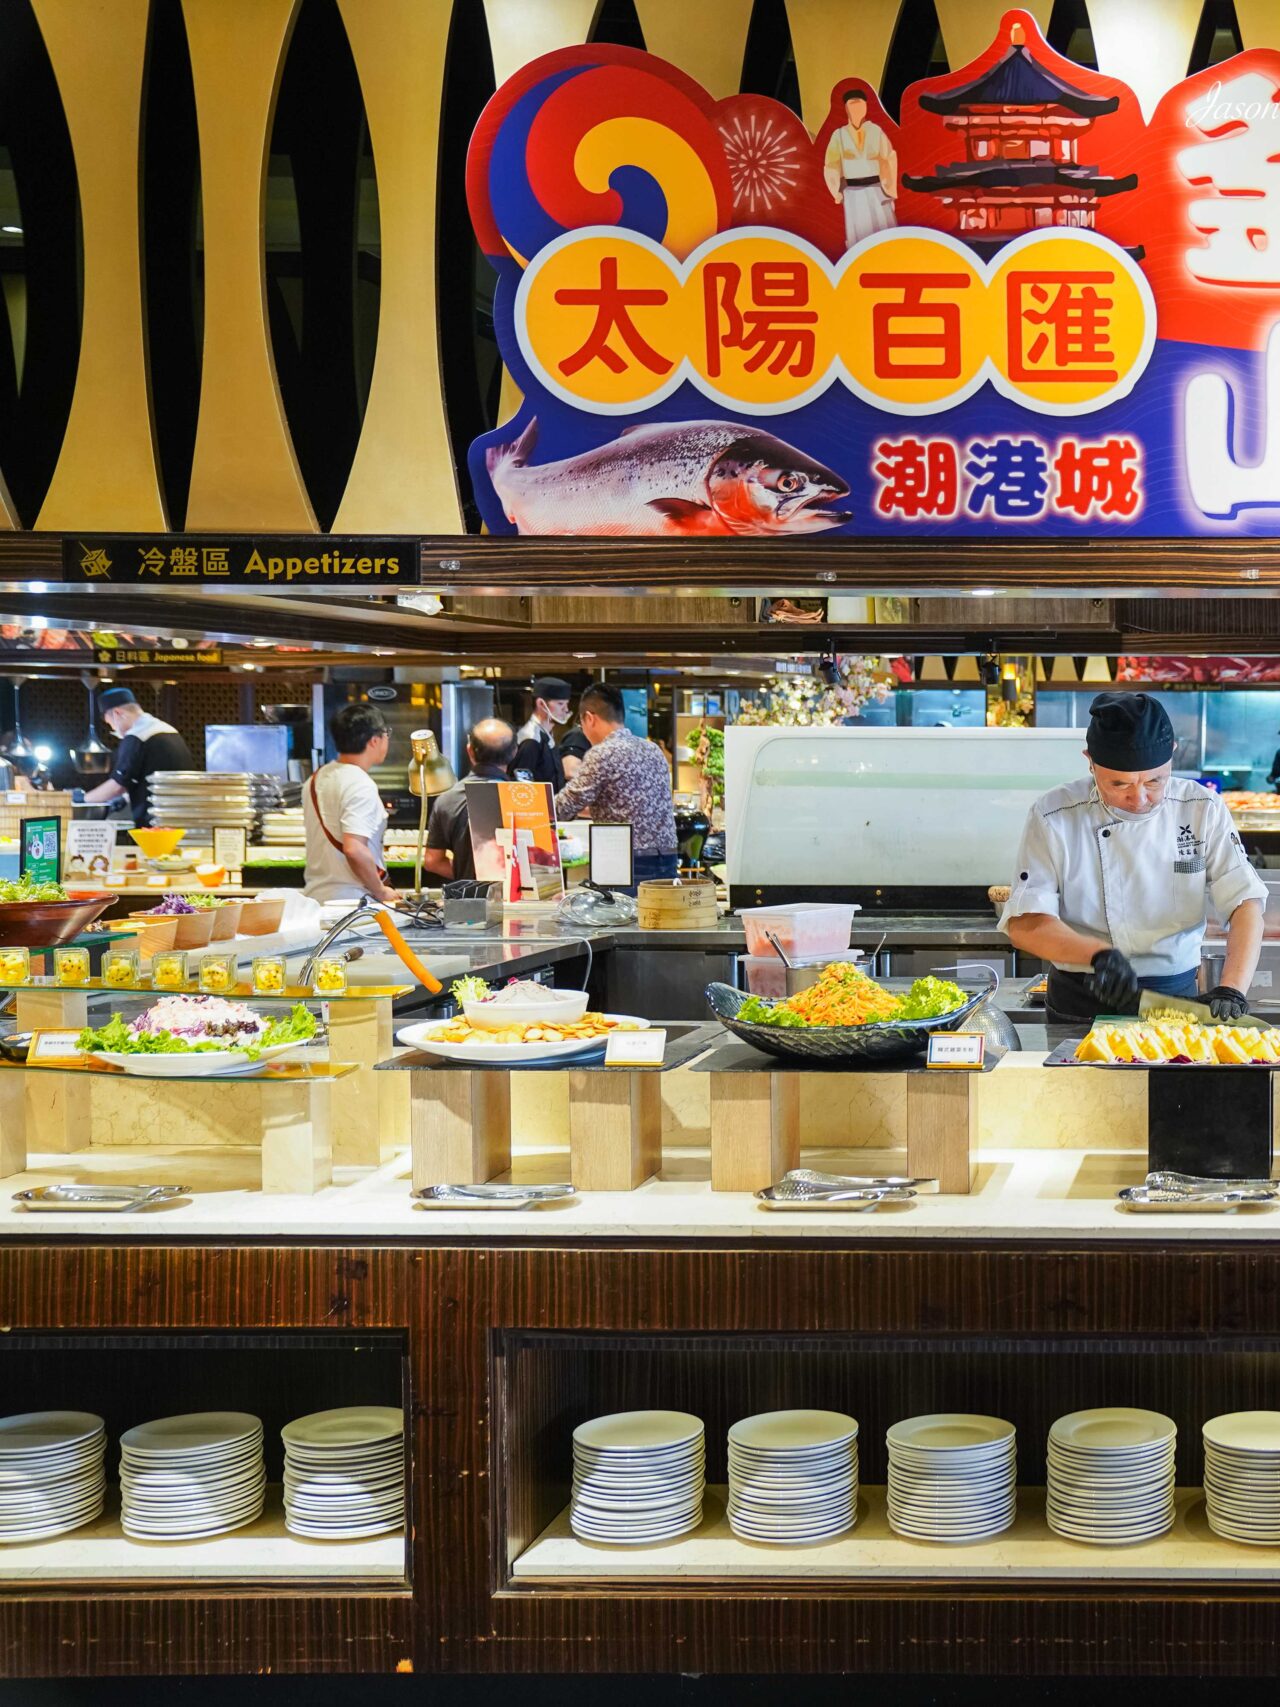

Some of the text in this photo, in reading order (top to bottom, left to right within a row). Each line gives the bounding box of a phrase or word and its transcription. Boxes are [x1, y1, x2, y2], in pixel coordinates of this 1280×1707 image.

[555, 257, 1118, 384] 太陽百匯
[878, 438, 1140, 518] 潮港城
[137, 547, 400, 581] 冷盤區 Appetizers
[154, 651, 195, 663] Japanese
